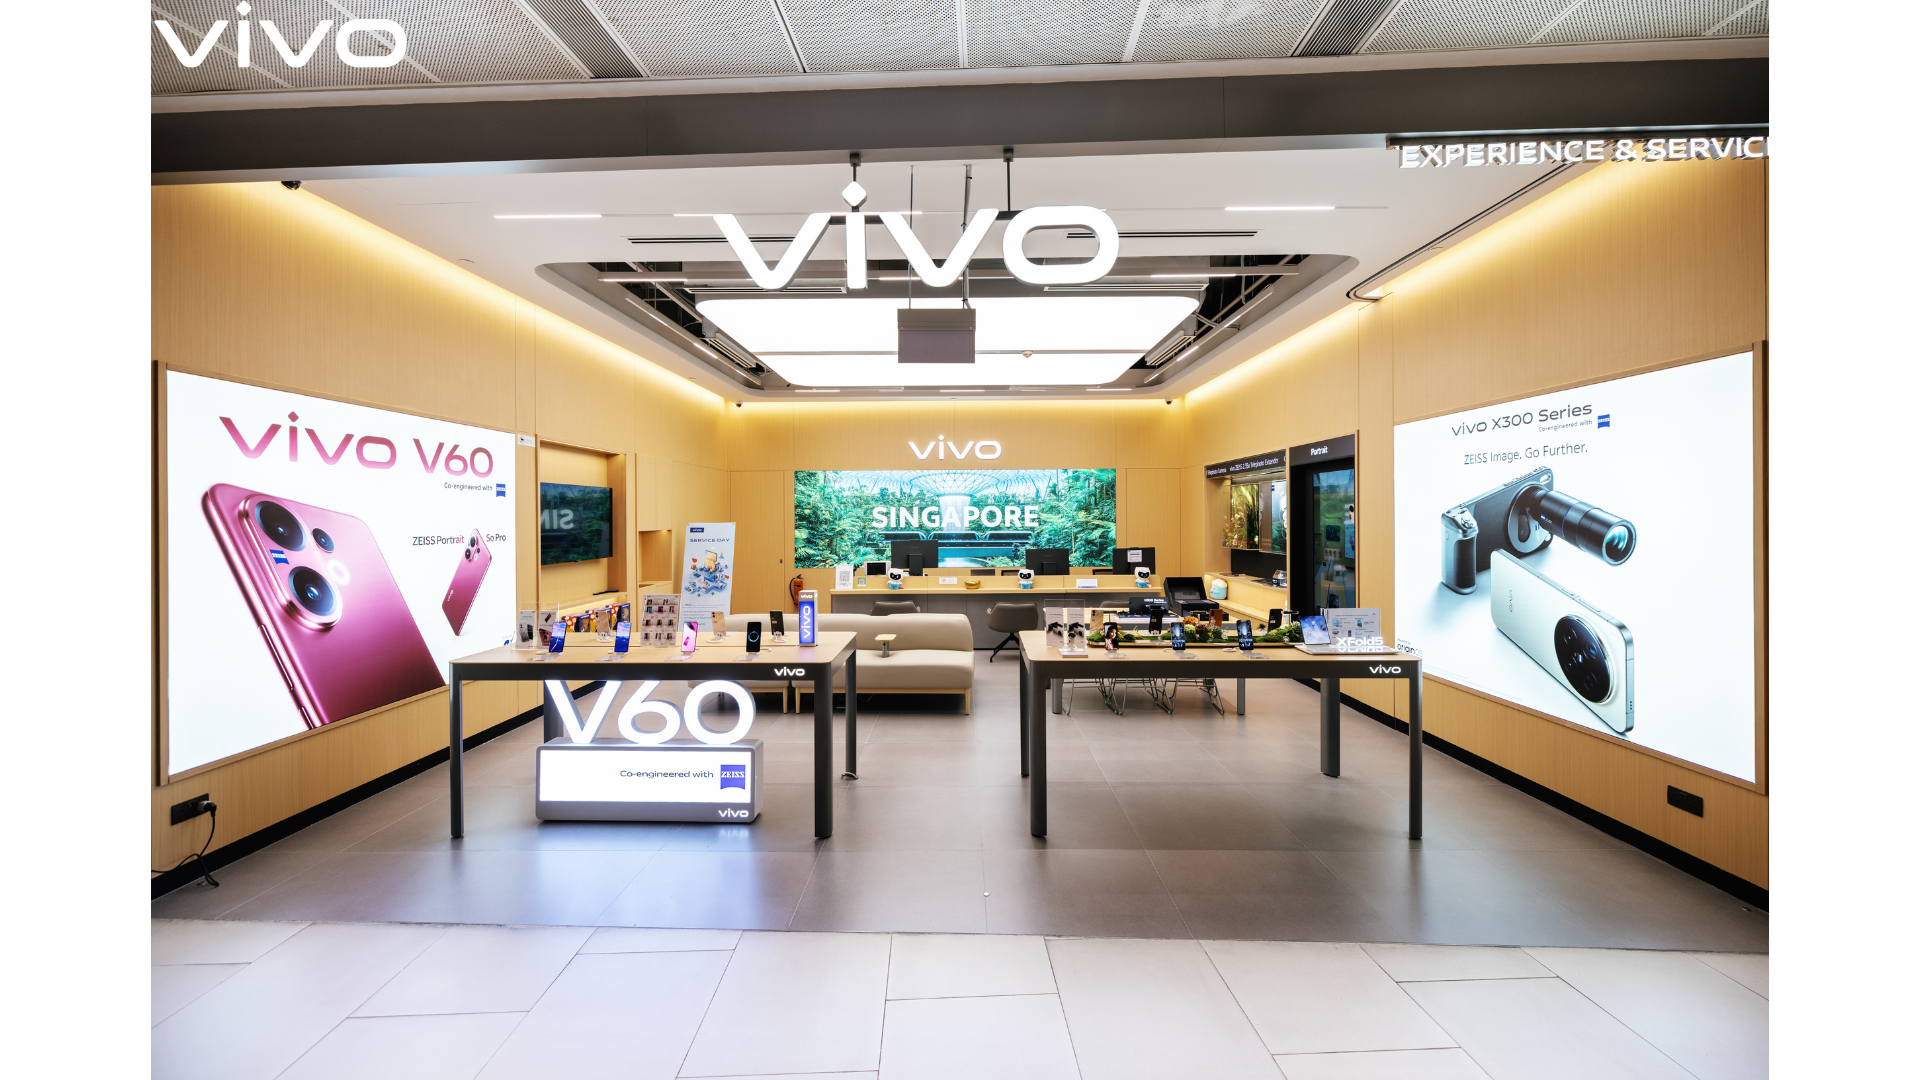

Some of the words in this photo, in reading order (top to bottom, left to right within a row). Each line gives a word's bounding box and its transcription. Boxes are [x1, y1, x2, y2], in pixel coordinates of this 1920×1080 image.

[1400, 139, 1605, 168] EXPERIENCE
[1616, 137, 1638, 160] &
[1648, 136, 1769, 161] SERVIC
[713, 181, 1120, 290] vivo
[1451, 421, 1487, 436] vivo
[1491, 412, 1534, 430] X300
[1538, 404, 1593, 422] Series
[1538, 420, 1578, 433] Co-engineered
[1579, 418, 1593, 426] with
[219, 411, 397, 469] vivo
[413, 438, 494, 479] V60
[907, 434, 1002, 460] vivo
[1310, 445, 1328, 456] Portrait
[1463, 452, 1488, 465] ZEISS
[1490, 449, 1522, 463] Image.
[1524, 447, 1540, 459] Go
[1542, 443, 1588, 458] Further.
[444, 482, 482, 491] Co-engineered
[871, 505, 1039, 528] SINGAPORE
[412, 536, 436, 546] ZEISS
[436, 534, 465, 545] Portrait
[486, 534, 494, 542] So
[495, 533, 506, 542] Pro
[801, 606, 810, 639] vivo
[1337, 636, 1384, 646] XFold5
[774, 666, 806, 677] vivo
[1369, 664, 1402, 674] vivo
[544, 680, 756, 744] V60
[620, 770, 690, 779] Co-engineered
[692, 770, 714, 778] with
[718, 808, 748, 818] vivo
